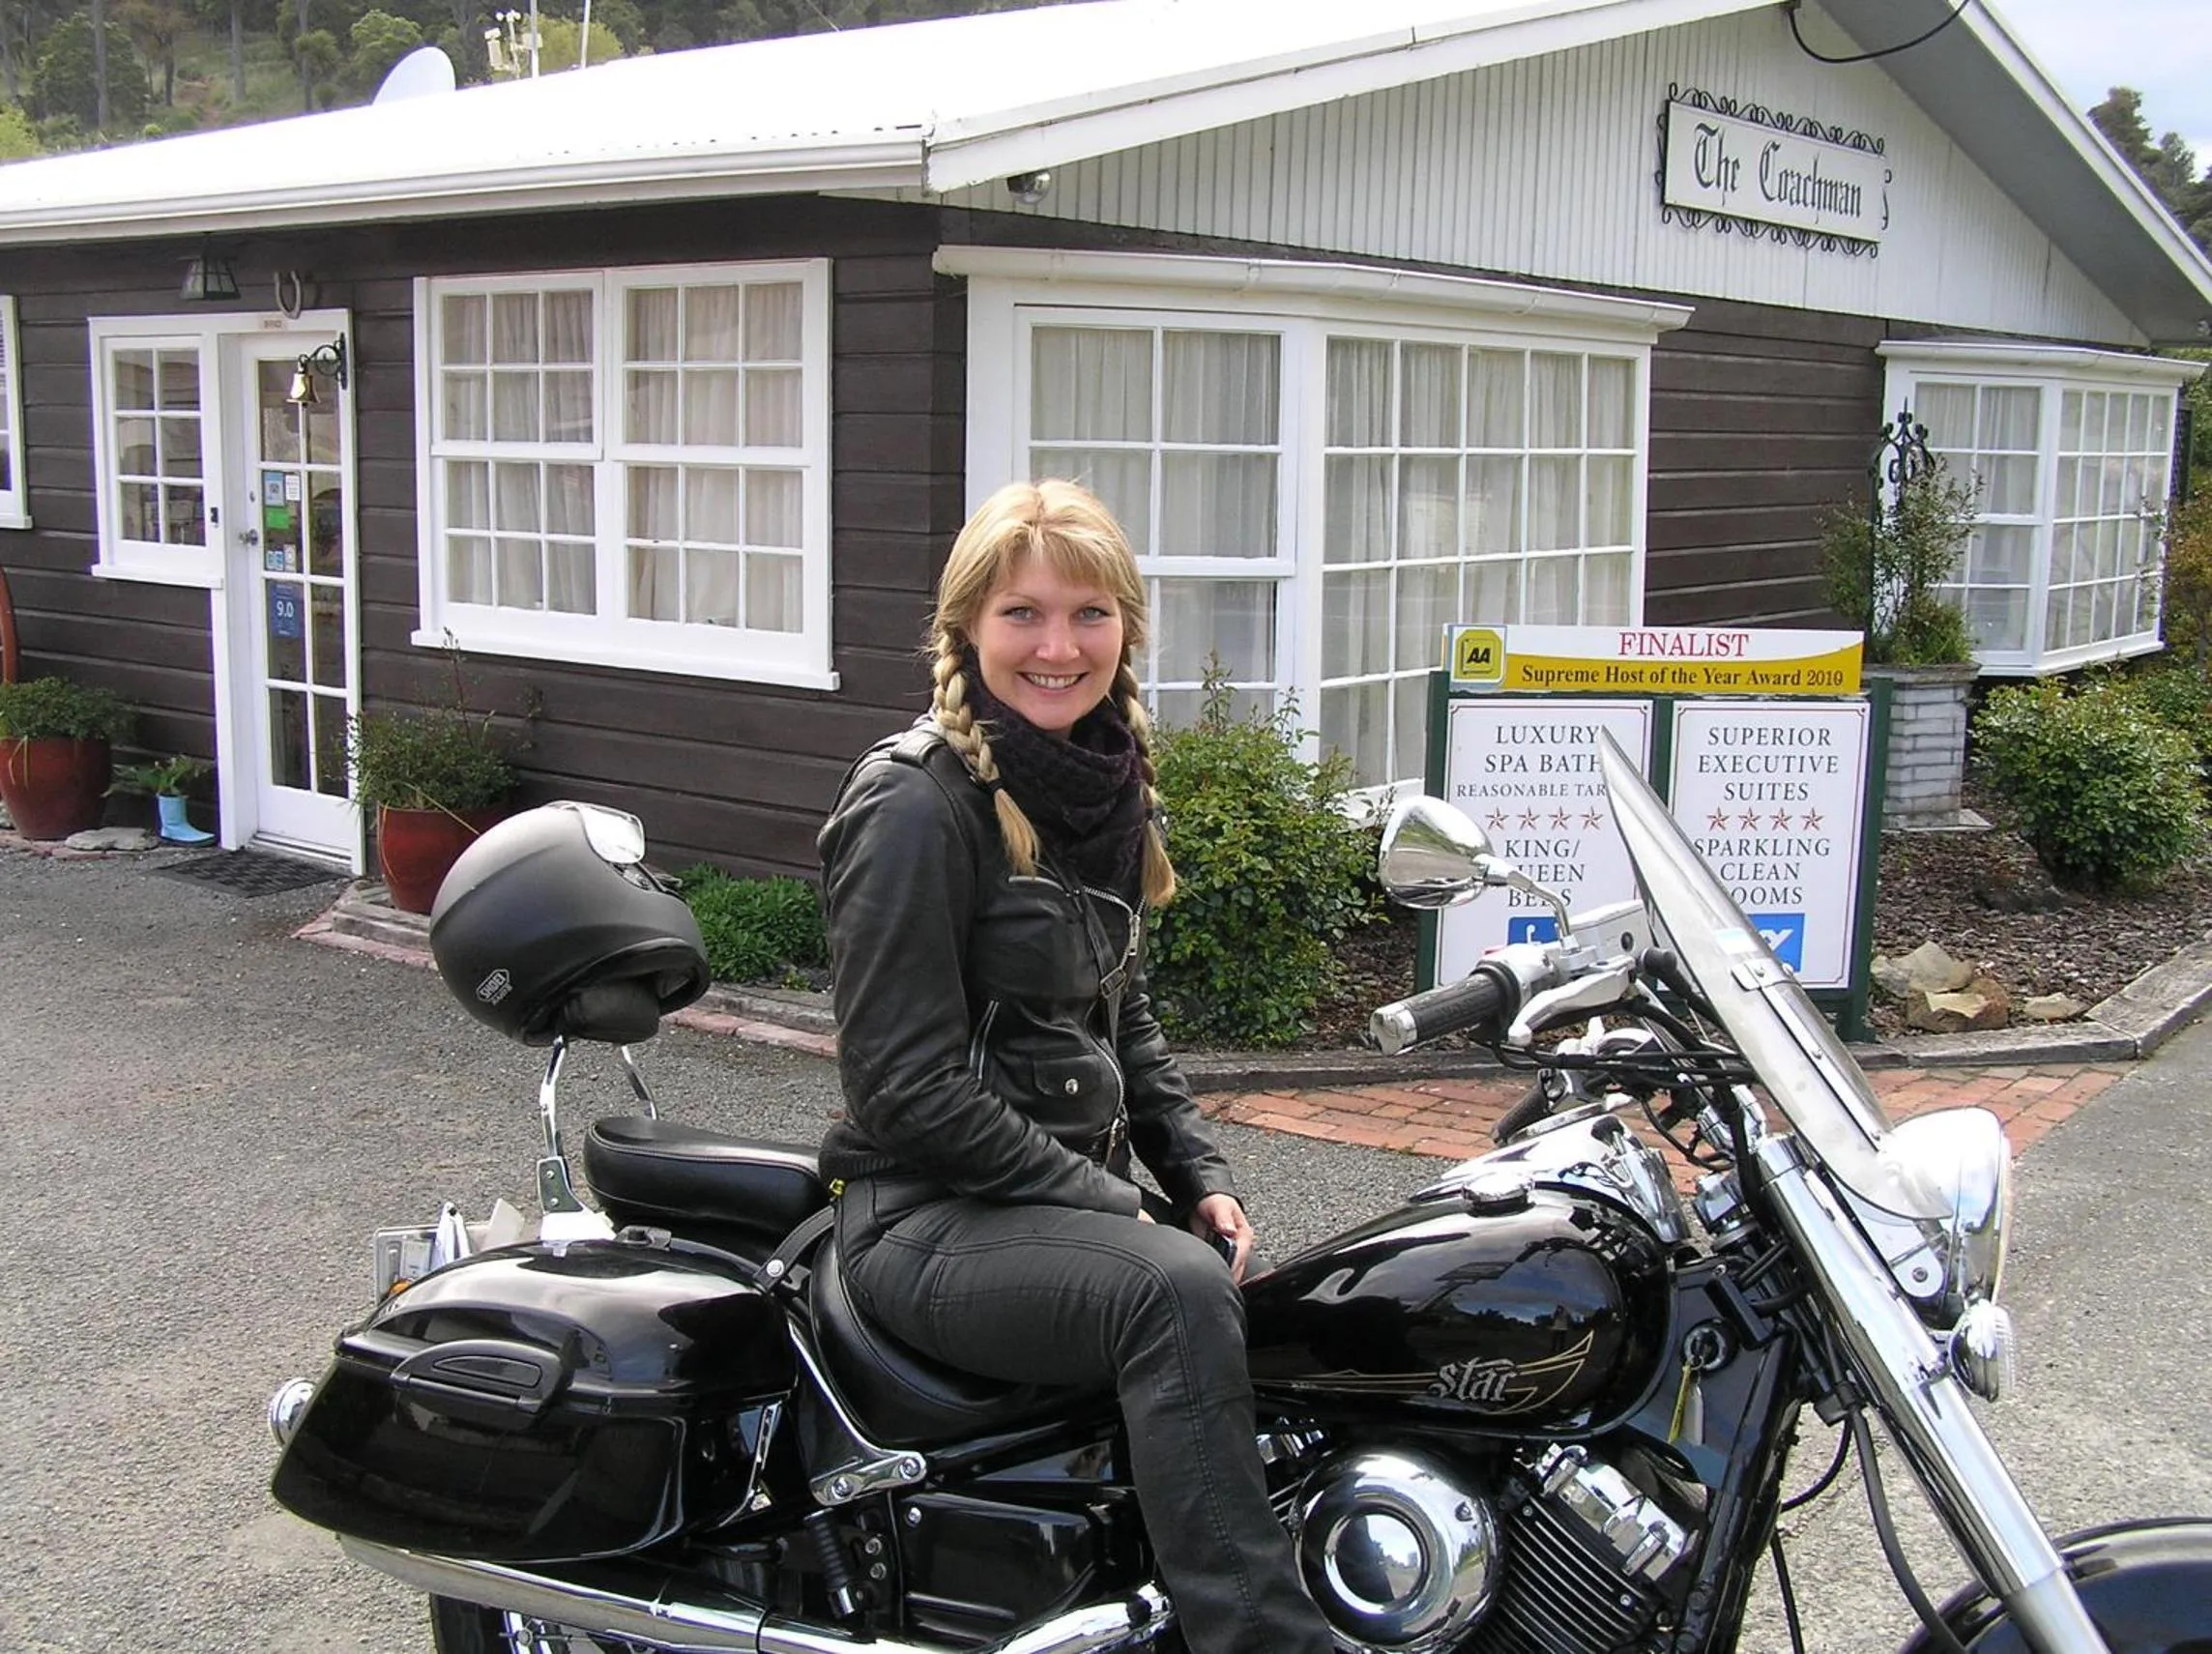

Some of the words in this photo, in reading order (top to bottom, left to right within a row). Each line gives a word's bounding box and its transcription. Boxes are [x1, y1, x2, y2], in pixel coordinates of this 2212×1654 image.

[1694, 122, 1740, 206] The
[1759, 140, 1861, 224] Coachman
[276, 600, 295, 618] 9.0
[1617, 632, 1749, 657] FINALIST
[1467, 647, 1491, 664] AA
[1522, 664, 1599, 686] Supreme
[1605, 665, 1645, 682] Host
[1649, 666, 1669, 684] of
[1672, 666, 1697, 684] the
[1703, 667, 1741, 684] Year
[1746, 669, 1801, 686] Award
[1496, 725, 1599, 744] LUXURY
[1707, 727, 1832, 746] SUPERIOR
[1484, 754, 1528, 773] SPA
[1698, 754, 1839, 773] EXECUTIVE
[1456, 784, 1569, 798] REASONABLE
[1574, 784, 1607, 798] TAR
[1724, 782, 1809, 801] SUITES
[1505, 839, 1581, 858] KING/
[1694, 838, 1830, 856] SPARKLING
[1517, 863, 1585, 882] EEN
[1720, 862, 1800, 881] CLEAN
[1508, 888, 1571, 907] BES
[1731, 886, 1803, 905] OOMS
